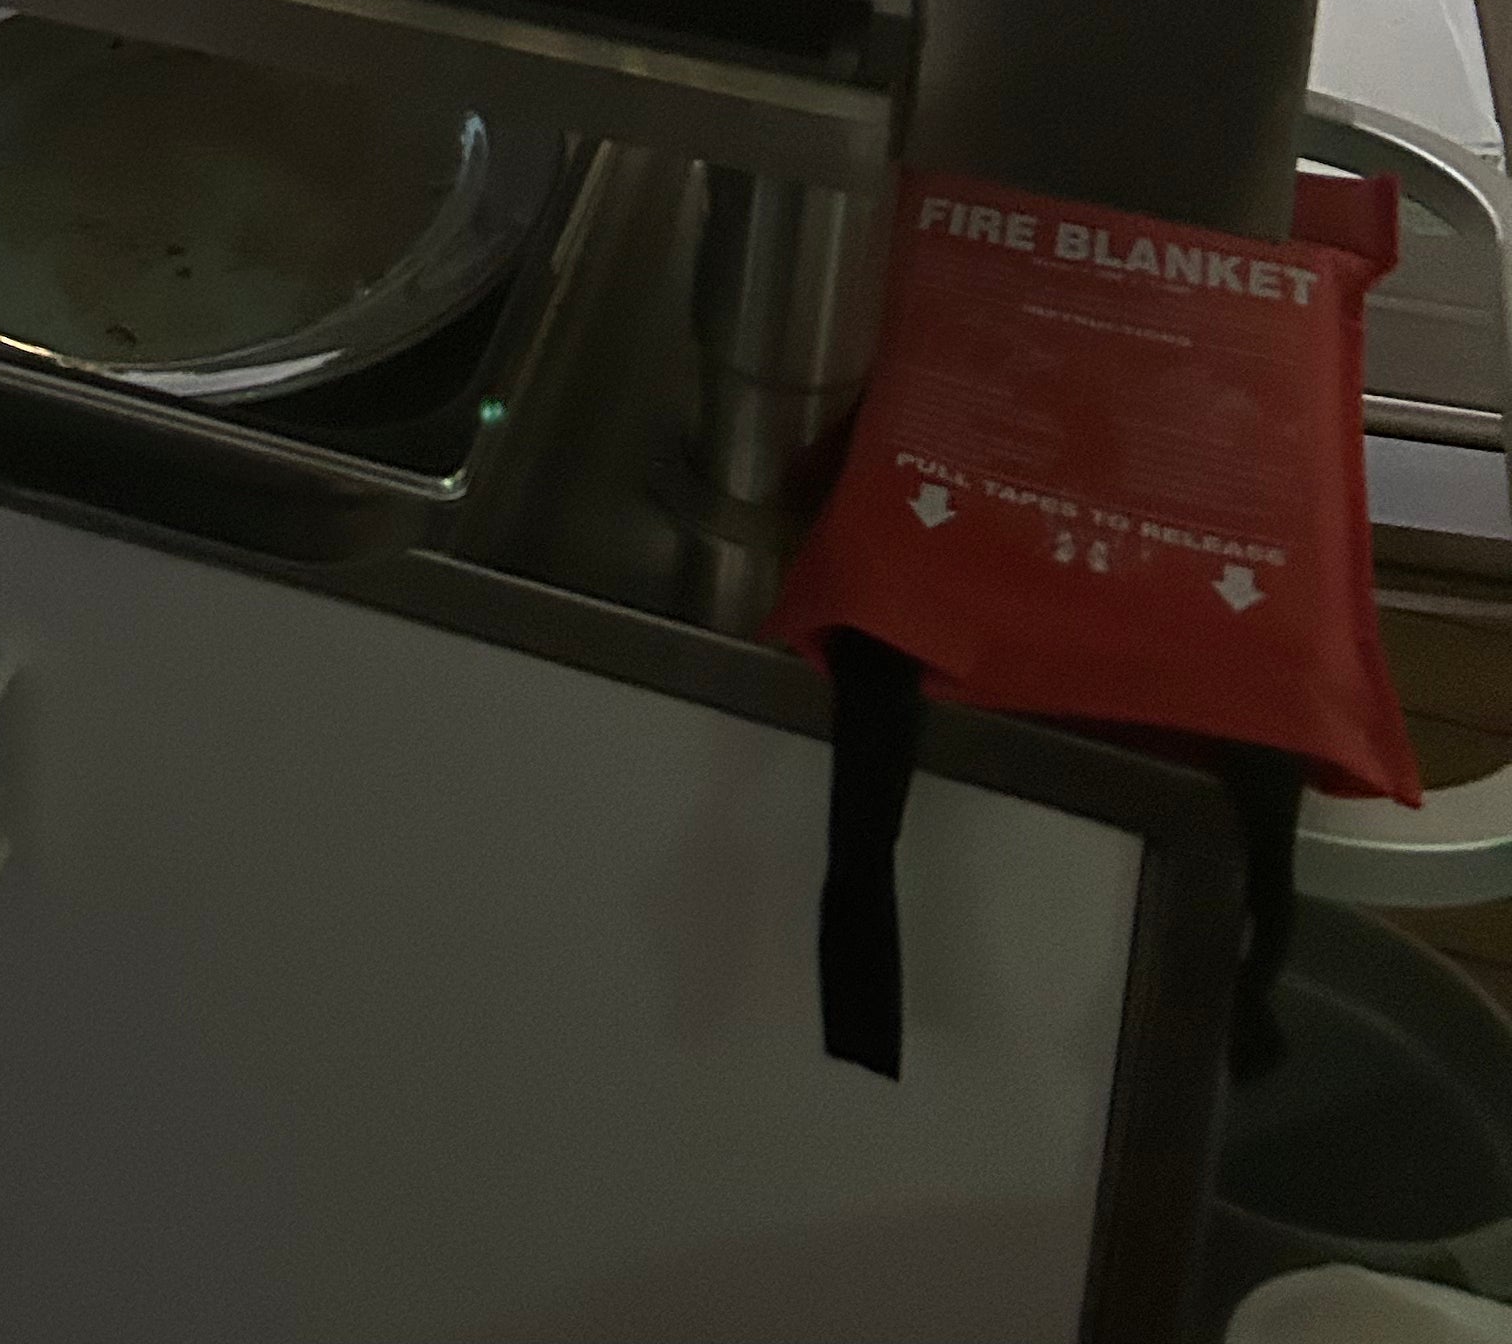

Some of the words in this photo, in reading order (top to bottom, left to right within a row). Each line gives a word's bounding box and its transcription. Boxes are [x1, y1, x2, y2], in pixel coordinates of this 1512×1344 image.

[917, 196, 1037, 252] FIRE
[1054, 222, 1319, 306] BLANKET
[895, 451, 971, 489] PULL
[983, 479, 1079, 519] TAPES
[1090, 507, 1131, 532] TO
[1139, 520, 1288, 567] RELEASE
